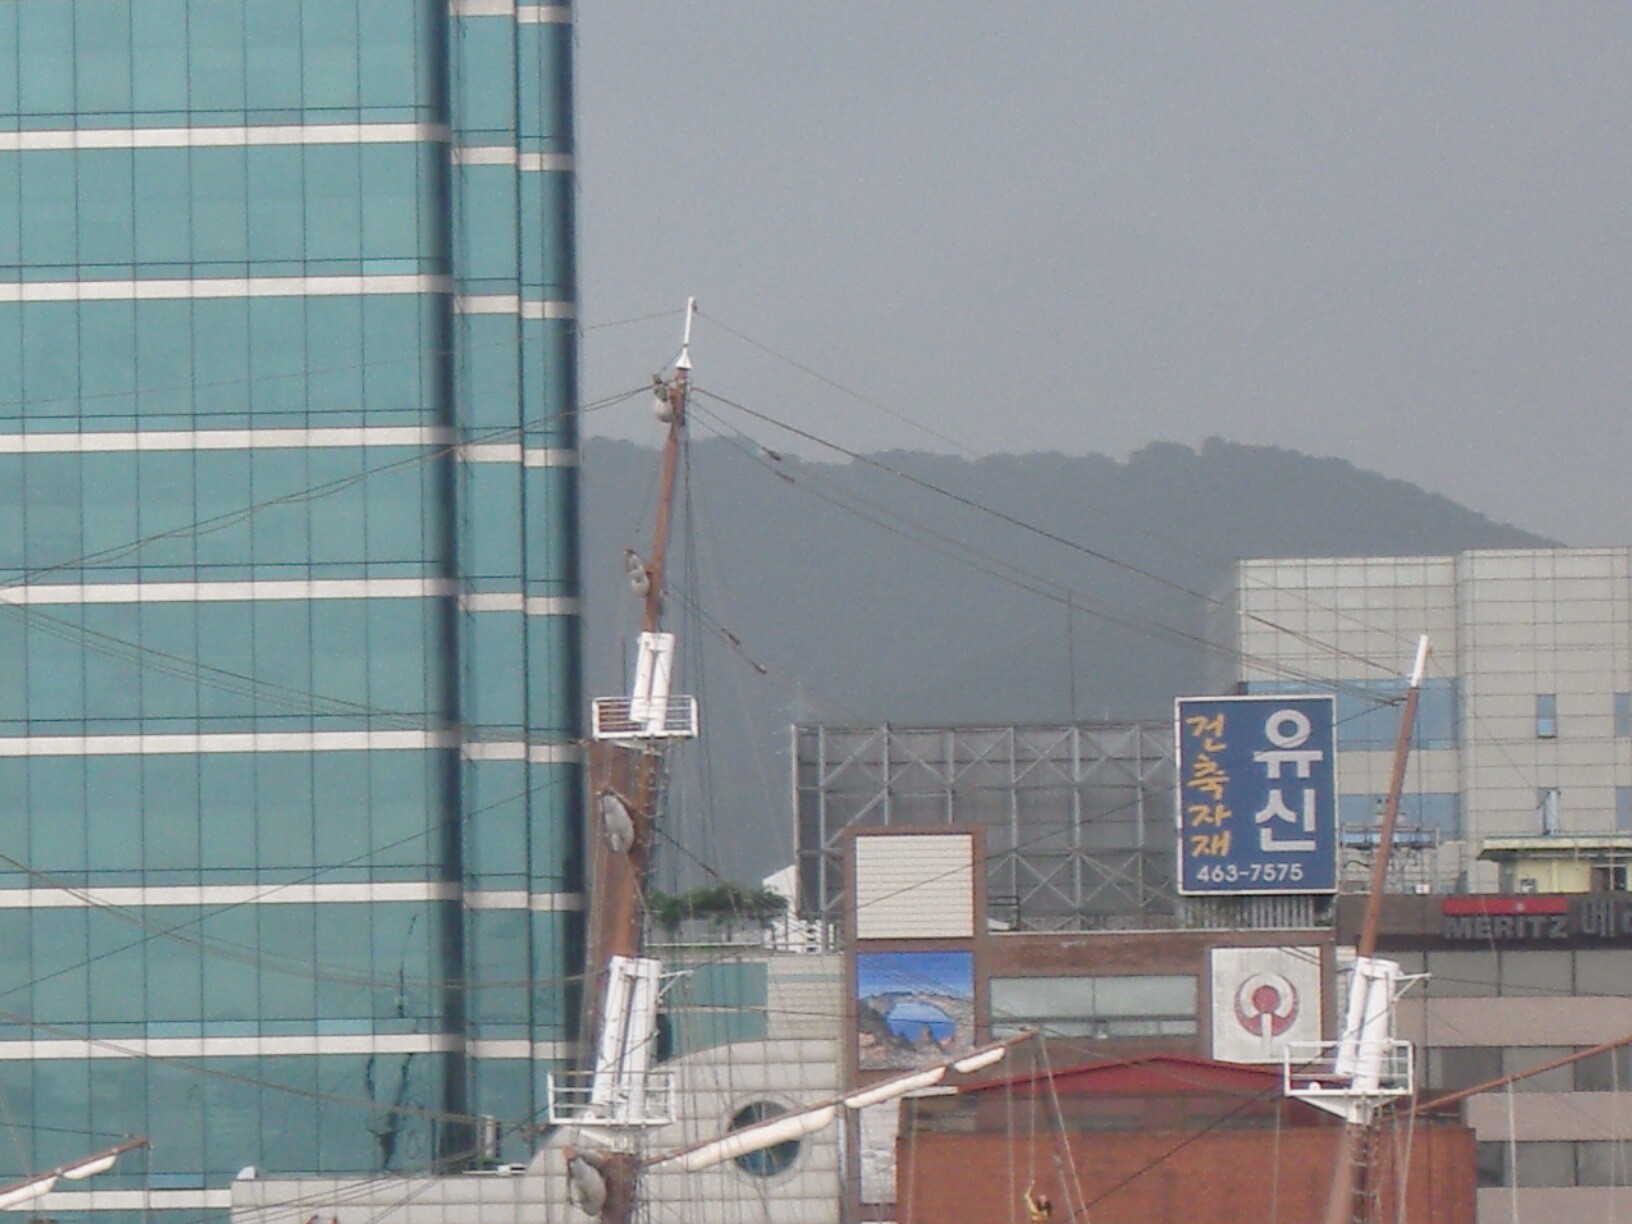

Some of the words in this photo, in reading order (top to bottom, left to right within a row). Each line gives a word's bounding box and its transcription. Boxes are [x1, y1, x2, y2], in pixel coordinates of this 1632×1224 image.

[1185, 712, 1233, 858] 건축자재
[1252, 708, 1324, 853] 유신
[1195, 861, 1304, 883] 463-7575
[1445, 914, 1568, 939] MERITZ
[1580, 897, 1632, 938] 메
